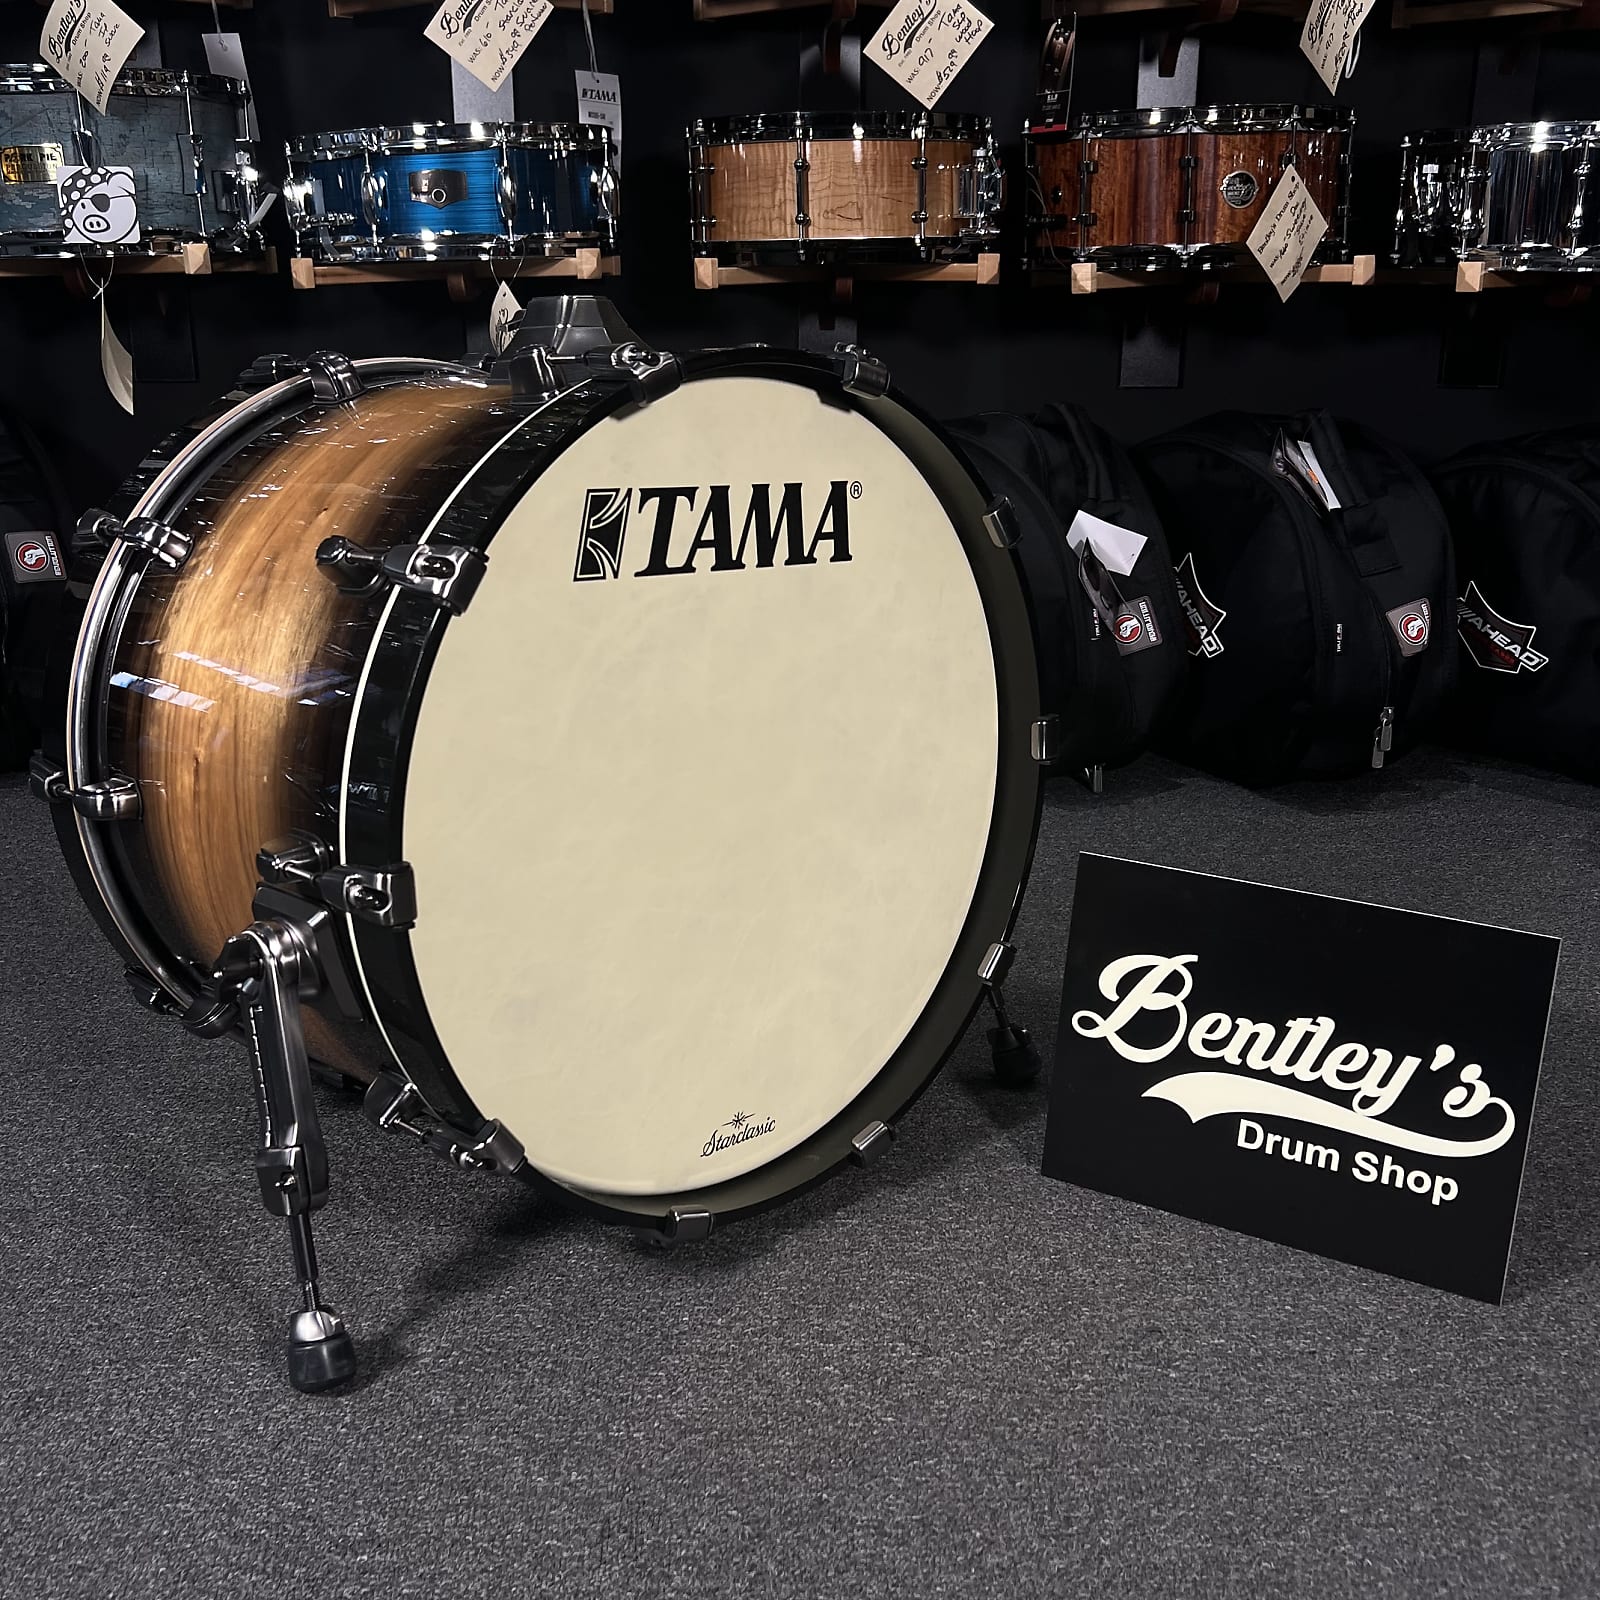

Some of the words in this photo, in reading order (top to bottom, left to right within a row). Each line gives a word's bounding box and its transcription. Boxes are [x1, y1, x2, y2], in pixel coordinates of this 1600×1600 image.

[80, 12, 91, 30] Shop
[915, 25, 930, 43] Drum
[927, 9, 942, 27] Shop
[918, 47, 934, 66] 917
[40, 152, 58, 161] PIE
[1275, 201, 1290, 222] Drum
[633, 480, 853, 578] TAMA
[1178, 590, 1218, 652] AHEAD
[1467, 616, 1541, 666] AHEAD
[1072, 954, 1493, 1118] Bentley's
[700, 1116, 776, 1158] Starclassic
[1237, 1118, 1340, 1173] Drum
[1351, 1151, 1459, 1207] Shop
